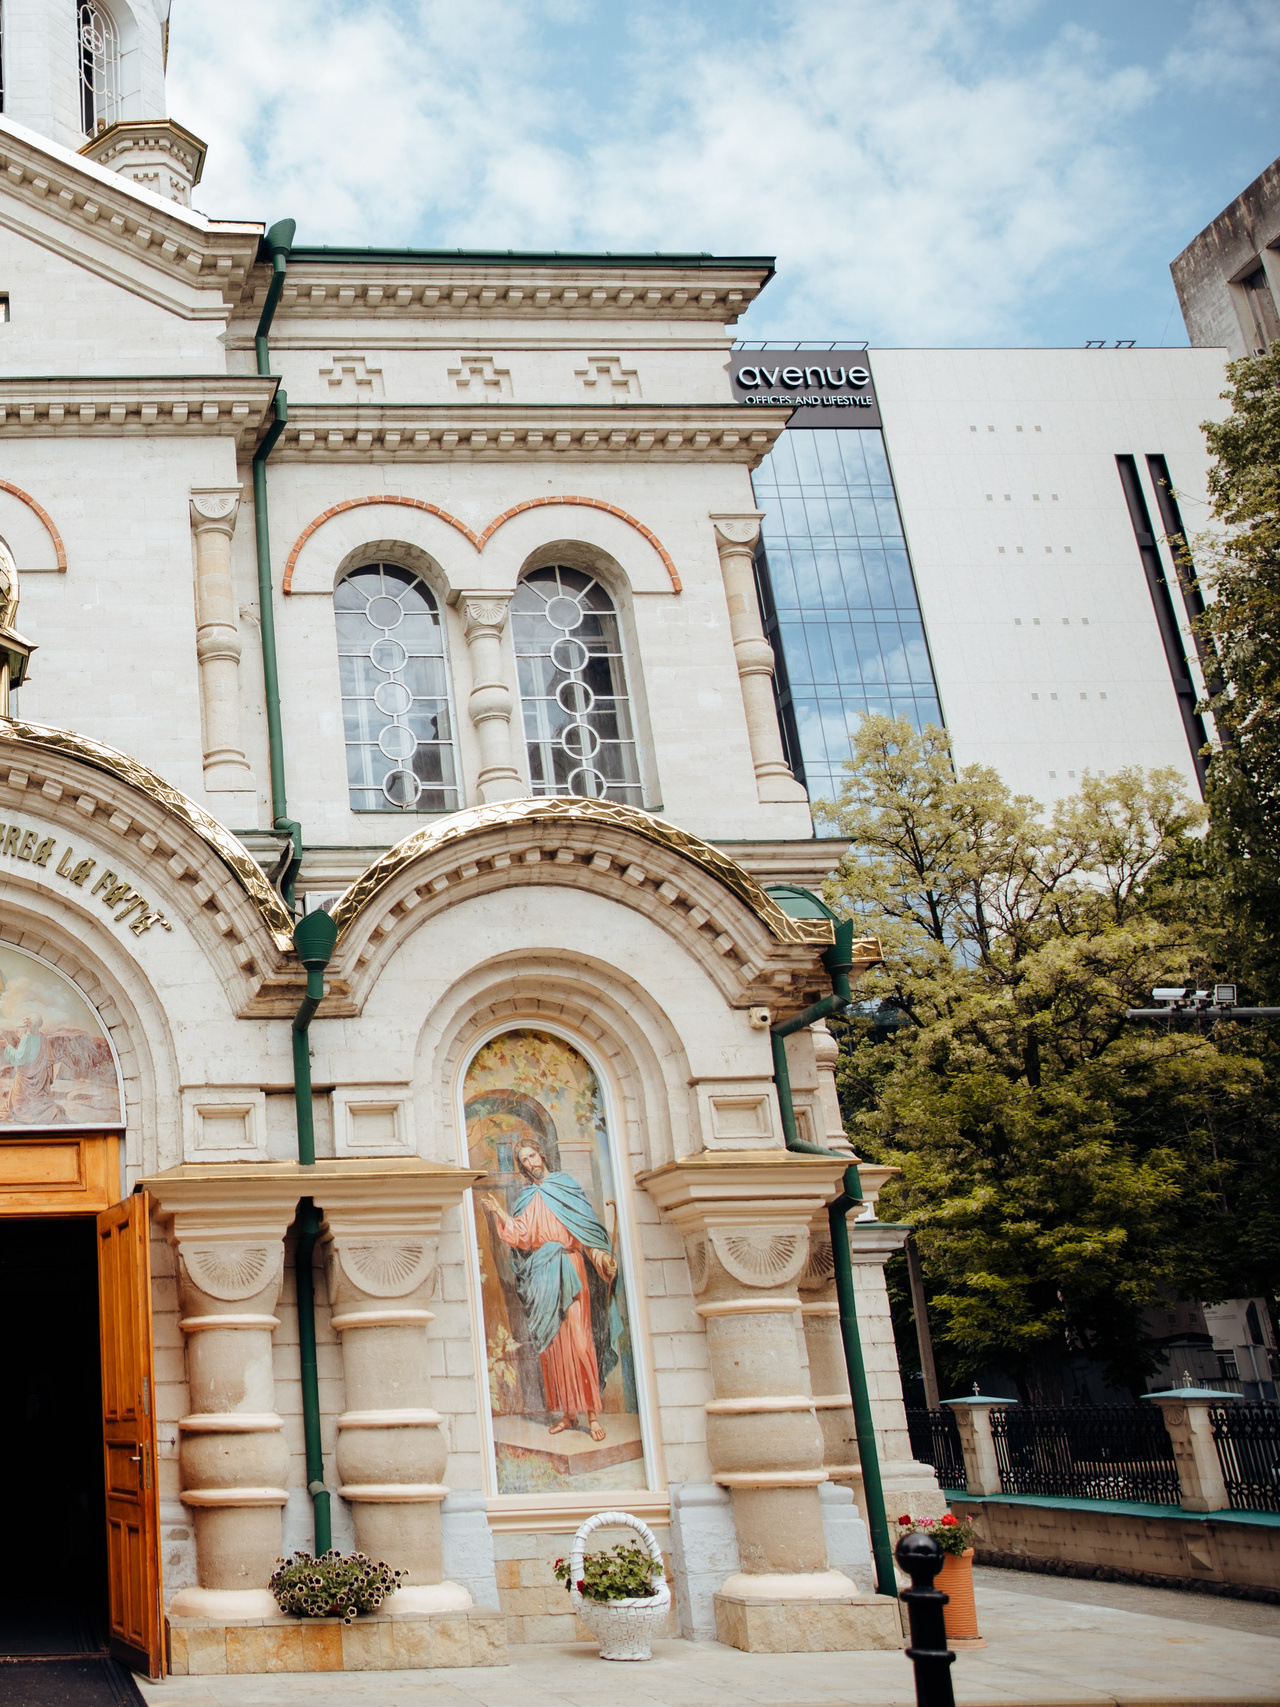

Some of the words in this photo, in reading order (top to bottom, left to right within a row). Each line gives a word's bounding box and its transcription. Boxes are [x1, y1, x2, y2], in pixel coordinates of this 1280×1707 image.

[738, 366, 870, 386] avenue
[795, 395, 820, 405] AND
[823, 395, 873, 405] LIFESTYLE
[55, 846, 97, 887] LA
